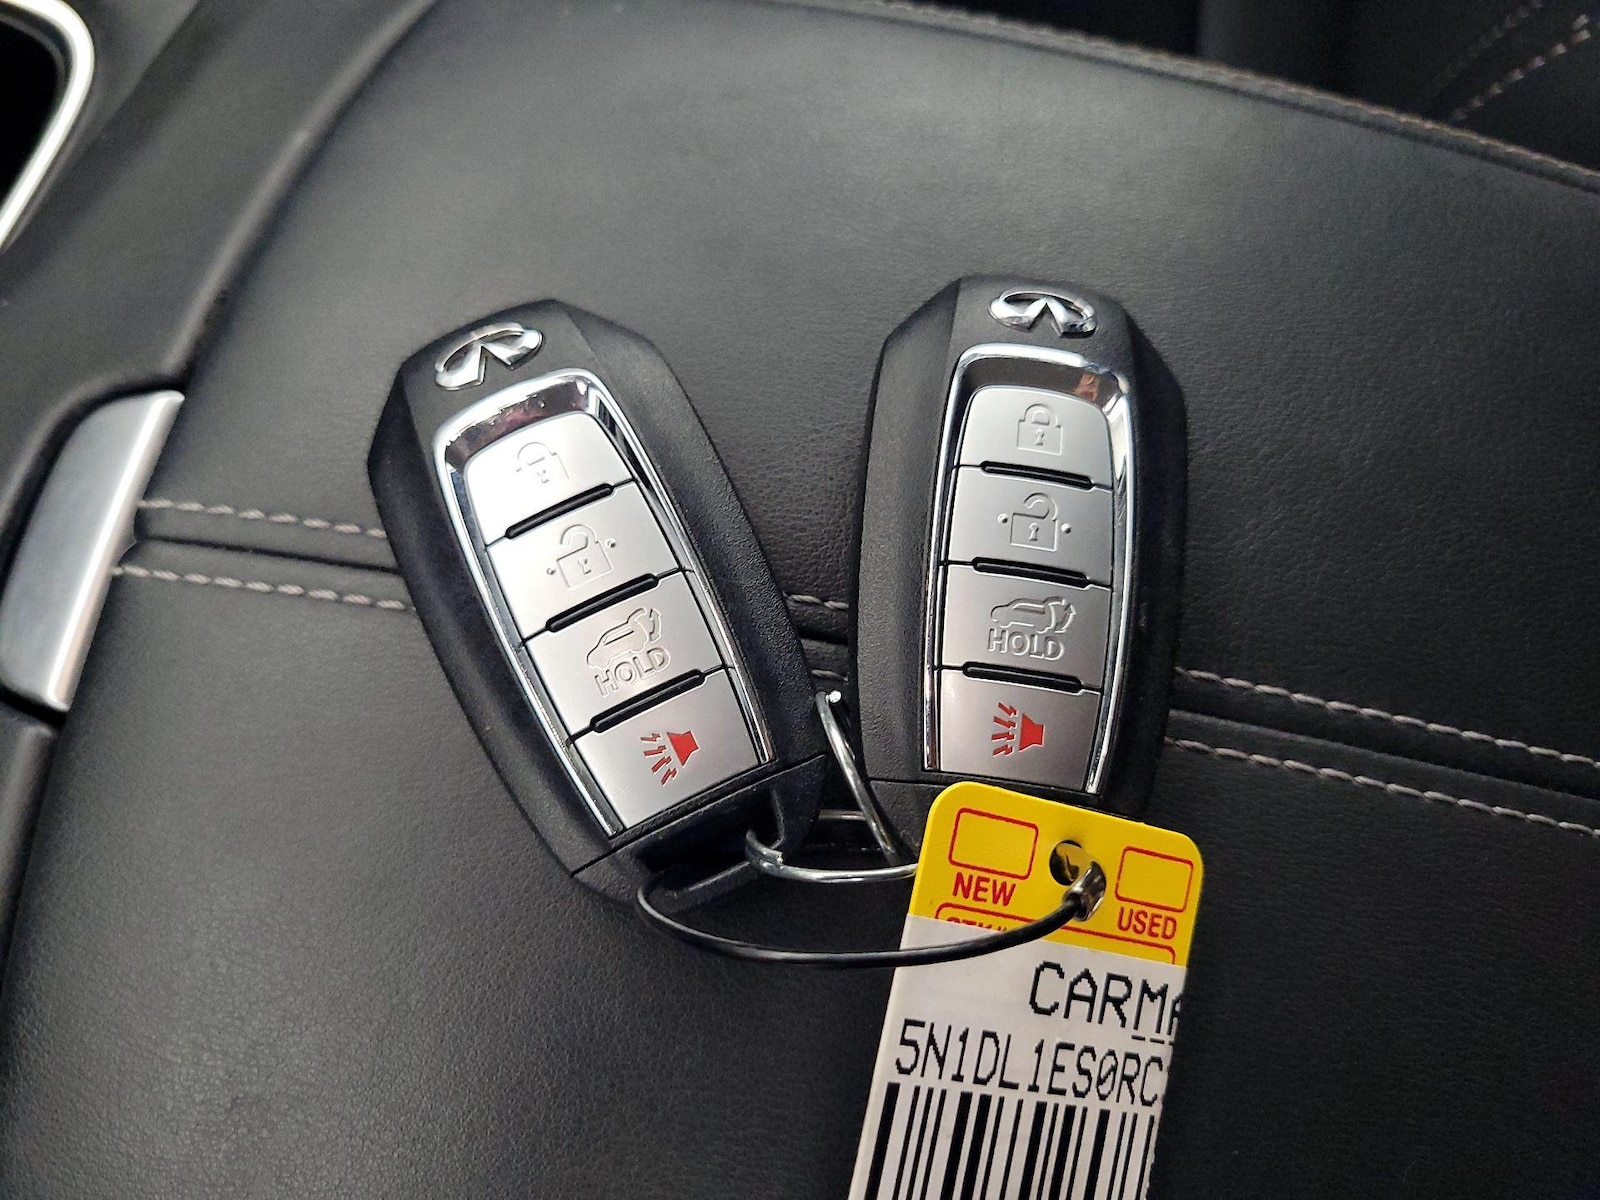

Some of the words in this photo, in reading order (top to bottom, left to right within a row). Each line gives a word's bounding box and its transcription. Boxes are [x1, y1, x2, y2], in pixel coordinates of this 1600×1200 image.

[987, 628, 1065, 660] HOLD
[594, 647, 671, 697] HOLD
[952, 872, 1016, 906] NEW
[1116, 906, 1177, 940] USED
